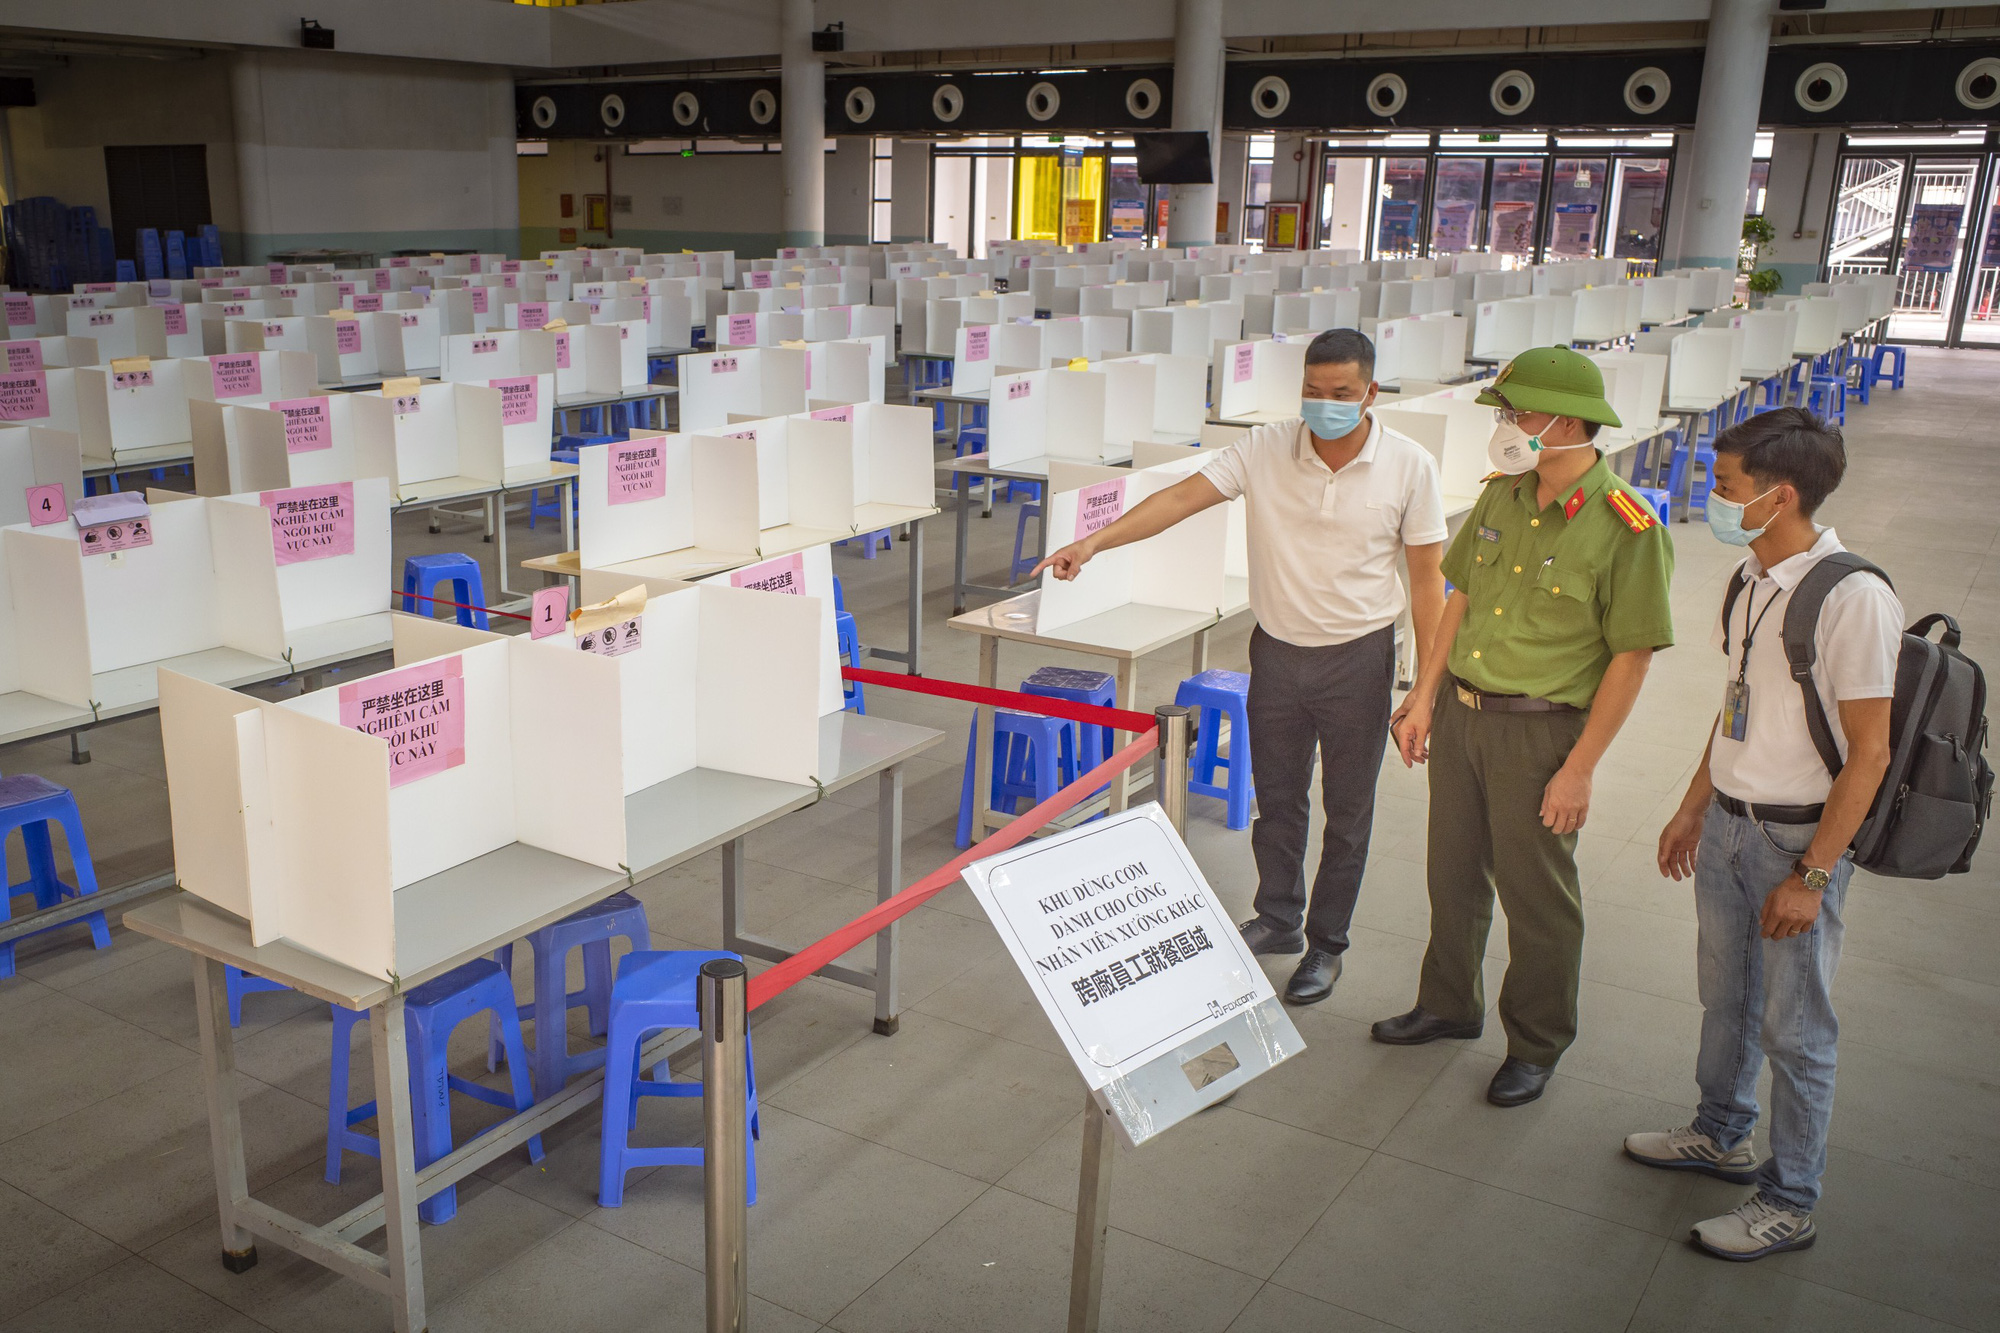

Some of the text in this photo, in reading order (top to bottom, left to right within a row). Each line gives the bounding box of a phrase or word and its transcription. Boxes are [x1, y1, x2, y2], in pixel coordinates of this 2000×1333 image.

[618, 447, 657, 463] 严禁坐在这里
[42, 498, 51, 511] 4
[276, 495, 339, 515] 严禁坐在这里
[1086, 490, 1118, 510] 严禁坐在这里
[273, 511, 318, 528] NGHIÊM
[313, 522, 336, 534] KHU
[286, 534, 334, 552] VỰC NÀY
[545, 604, 552, 622] 1
[362, 679, 444, 718] 严禁坐在这里
[410, 721, 440, 742] KHU
[408, 741, 437, 762] NÀY
[1037, 861, 1149, 915] KHU DÙNG CƠM
[1050, 881, 1167, 940] DÀNH CHO CÔNG
[1036, 894, 1206, 976] NHÂN VIÊN XƯỞNG KHÁC
[1071, 925, 1213, 1007] 跨廠員工就餐區域
